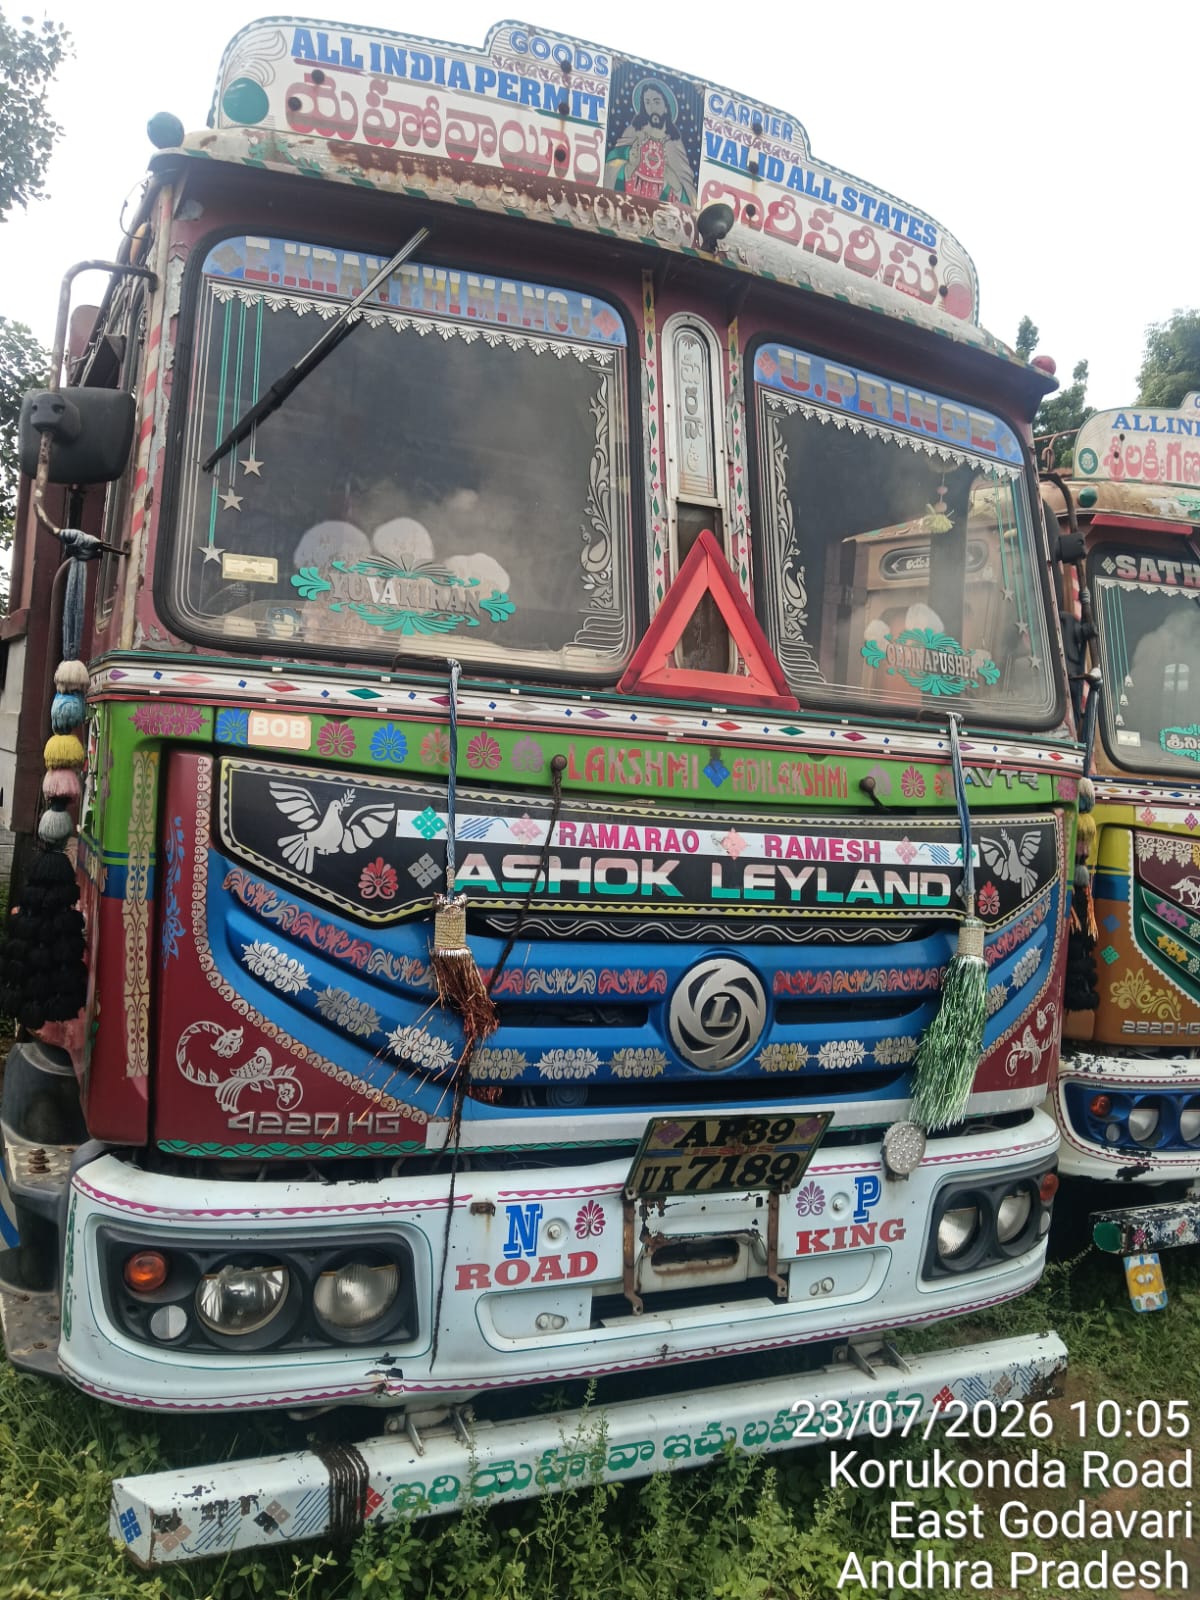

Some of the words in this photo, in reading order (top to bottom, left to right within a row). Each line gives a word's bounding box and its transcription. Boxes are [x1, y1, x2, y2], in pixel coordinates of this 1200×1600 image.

[290, 27, 363, 69] ALL
[370, 42, 473, 91] INDIA
[474, 64, 606, 122] PERMIT
[510, 31, 609, 76] GOODS
[708, 93, 793, 143] CARRIER
[704, 131, 784, 183] VALID
[790, 171, 838, 205] ALL
[842, 186, 938, 248] STATES
[252, 716, 306, 739] BOB
[568, 743, 699, 790] LAKSHMI
[732, 758, 848, 798] ADILAKSHMI
[558, 822, 700, 854] RAMARAO
[765, 834, 881, 864] RAMESH
[454, 853, 684, 897] ASHOK
[712, 863, 951, 906] LEYLAND
[1122, 1019, 1175, 1036] 2820
[227, 1111, 339, 1135] 4220
[348, 1112, 401, 1135] HG
[673, 1118, 795, 1149] AP39
[640, 1165, 675, 1193] UK
[685, 1152, 800, 1192] 7189
[853, 1175, 882, 1223] P
[503, 1203, 543, 1259] N
[795, 1219, 907, 1256] KING
[454, 1251, 599, 1291] ROAD
